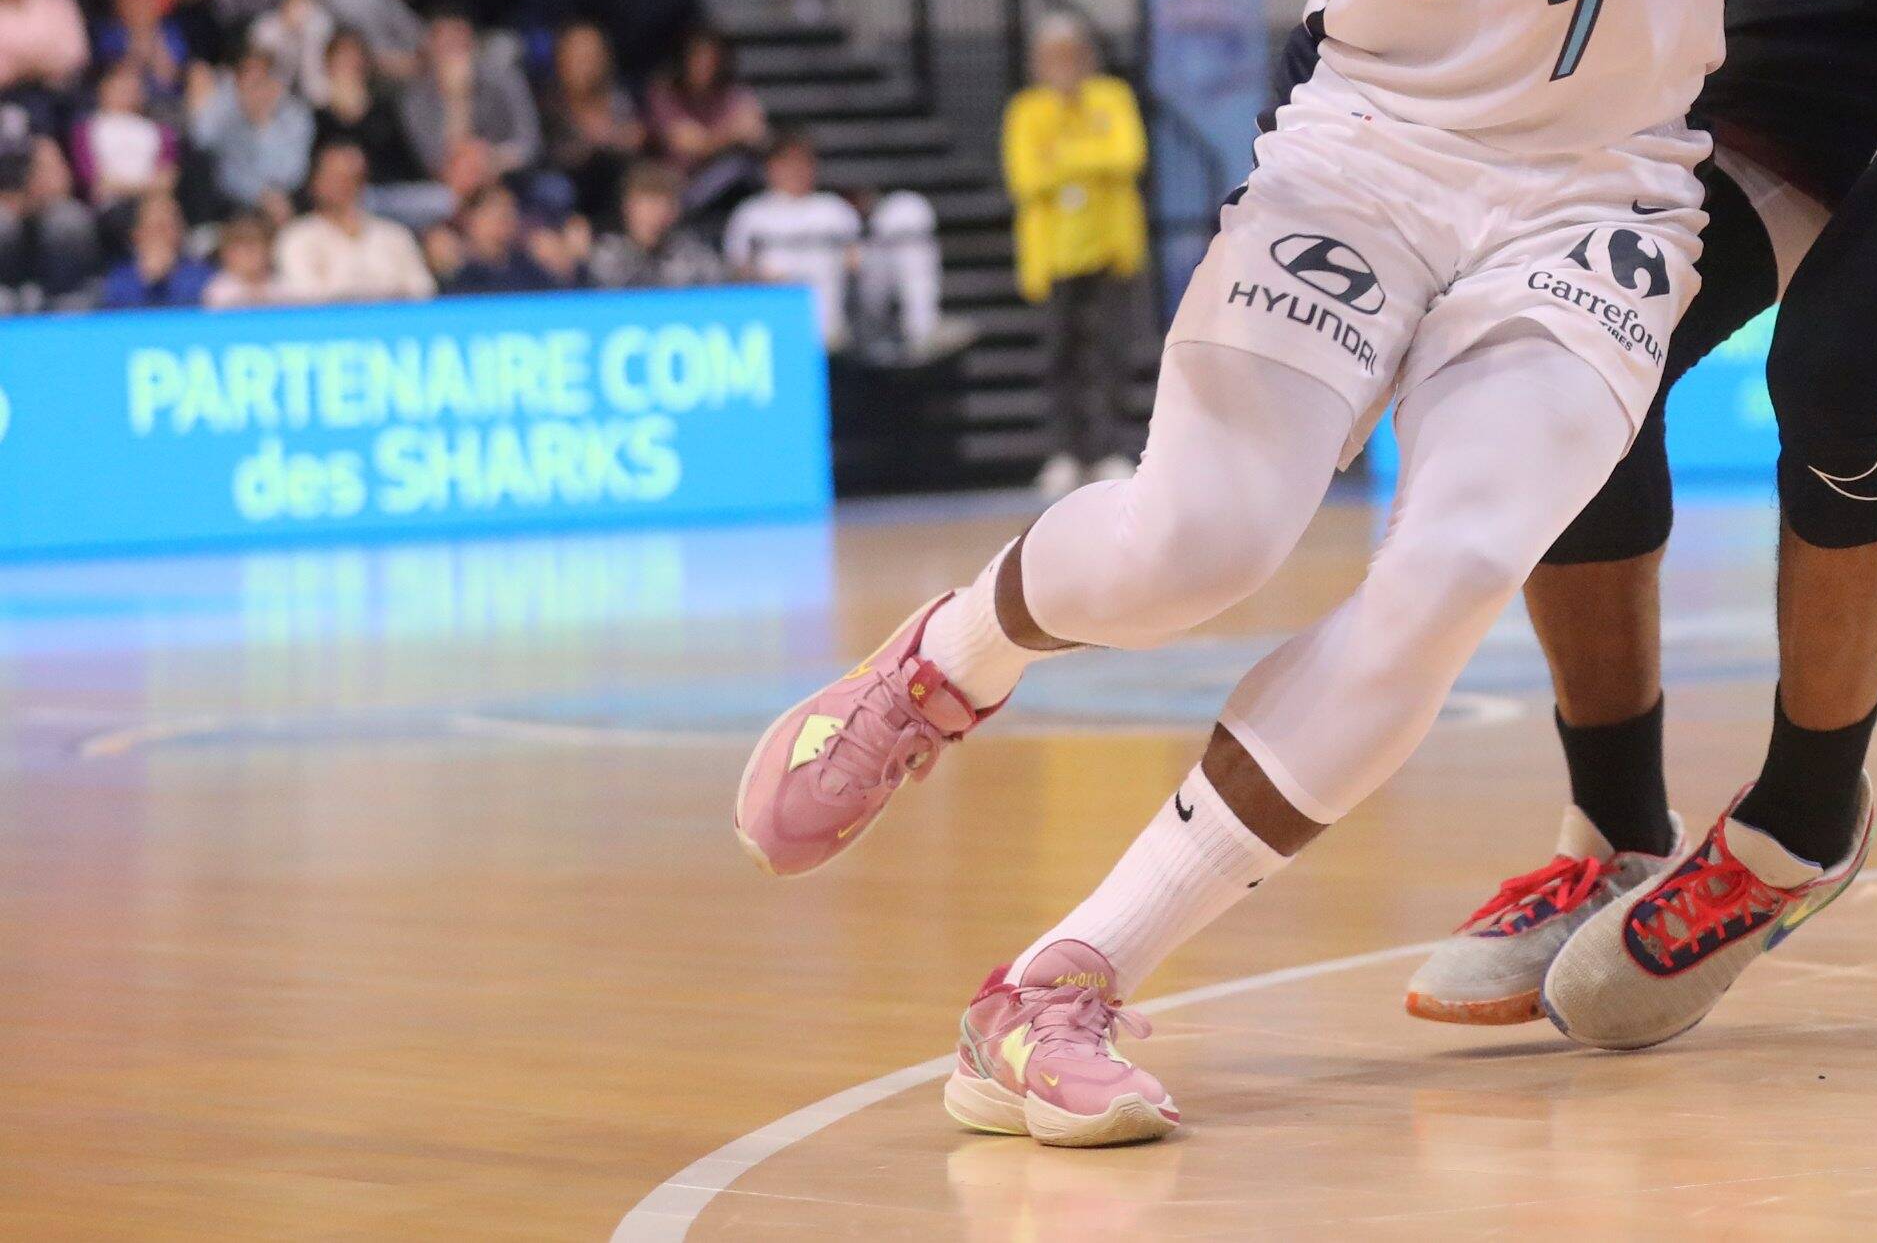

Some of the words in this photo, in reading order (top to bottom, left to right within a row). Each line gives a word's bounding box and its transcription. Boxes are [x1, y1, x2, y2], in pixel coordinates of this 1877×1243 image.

[1227, 281, 1378, 376] HYUNDAI
[1528, 270, 1664, 369] Carrefour
[127, 325, 594, 436] PARTENAIRE
[600, 320, 775, 413] COM
[231, 435, 367, 520] des
[374, 414, 683, 514] SHARKS
